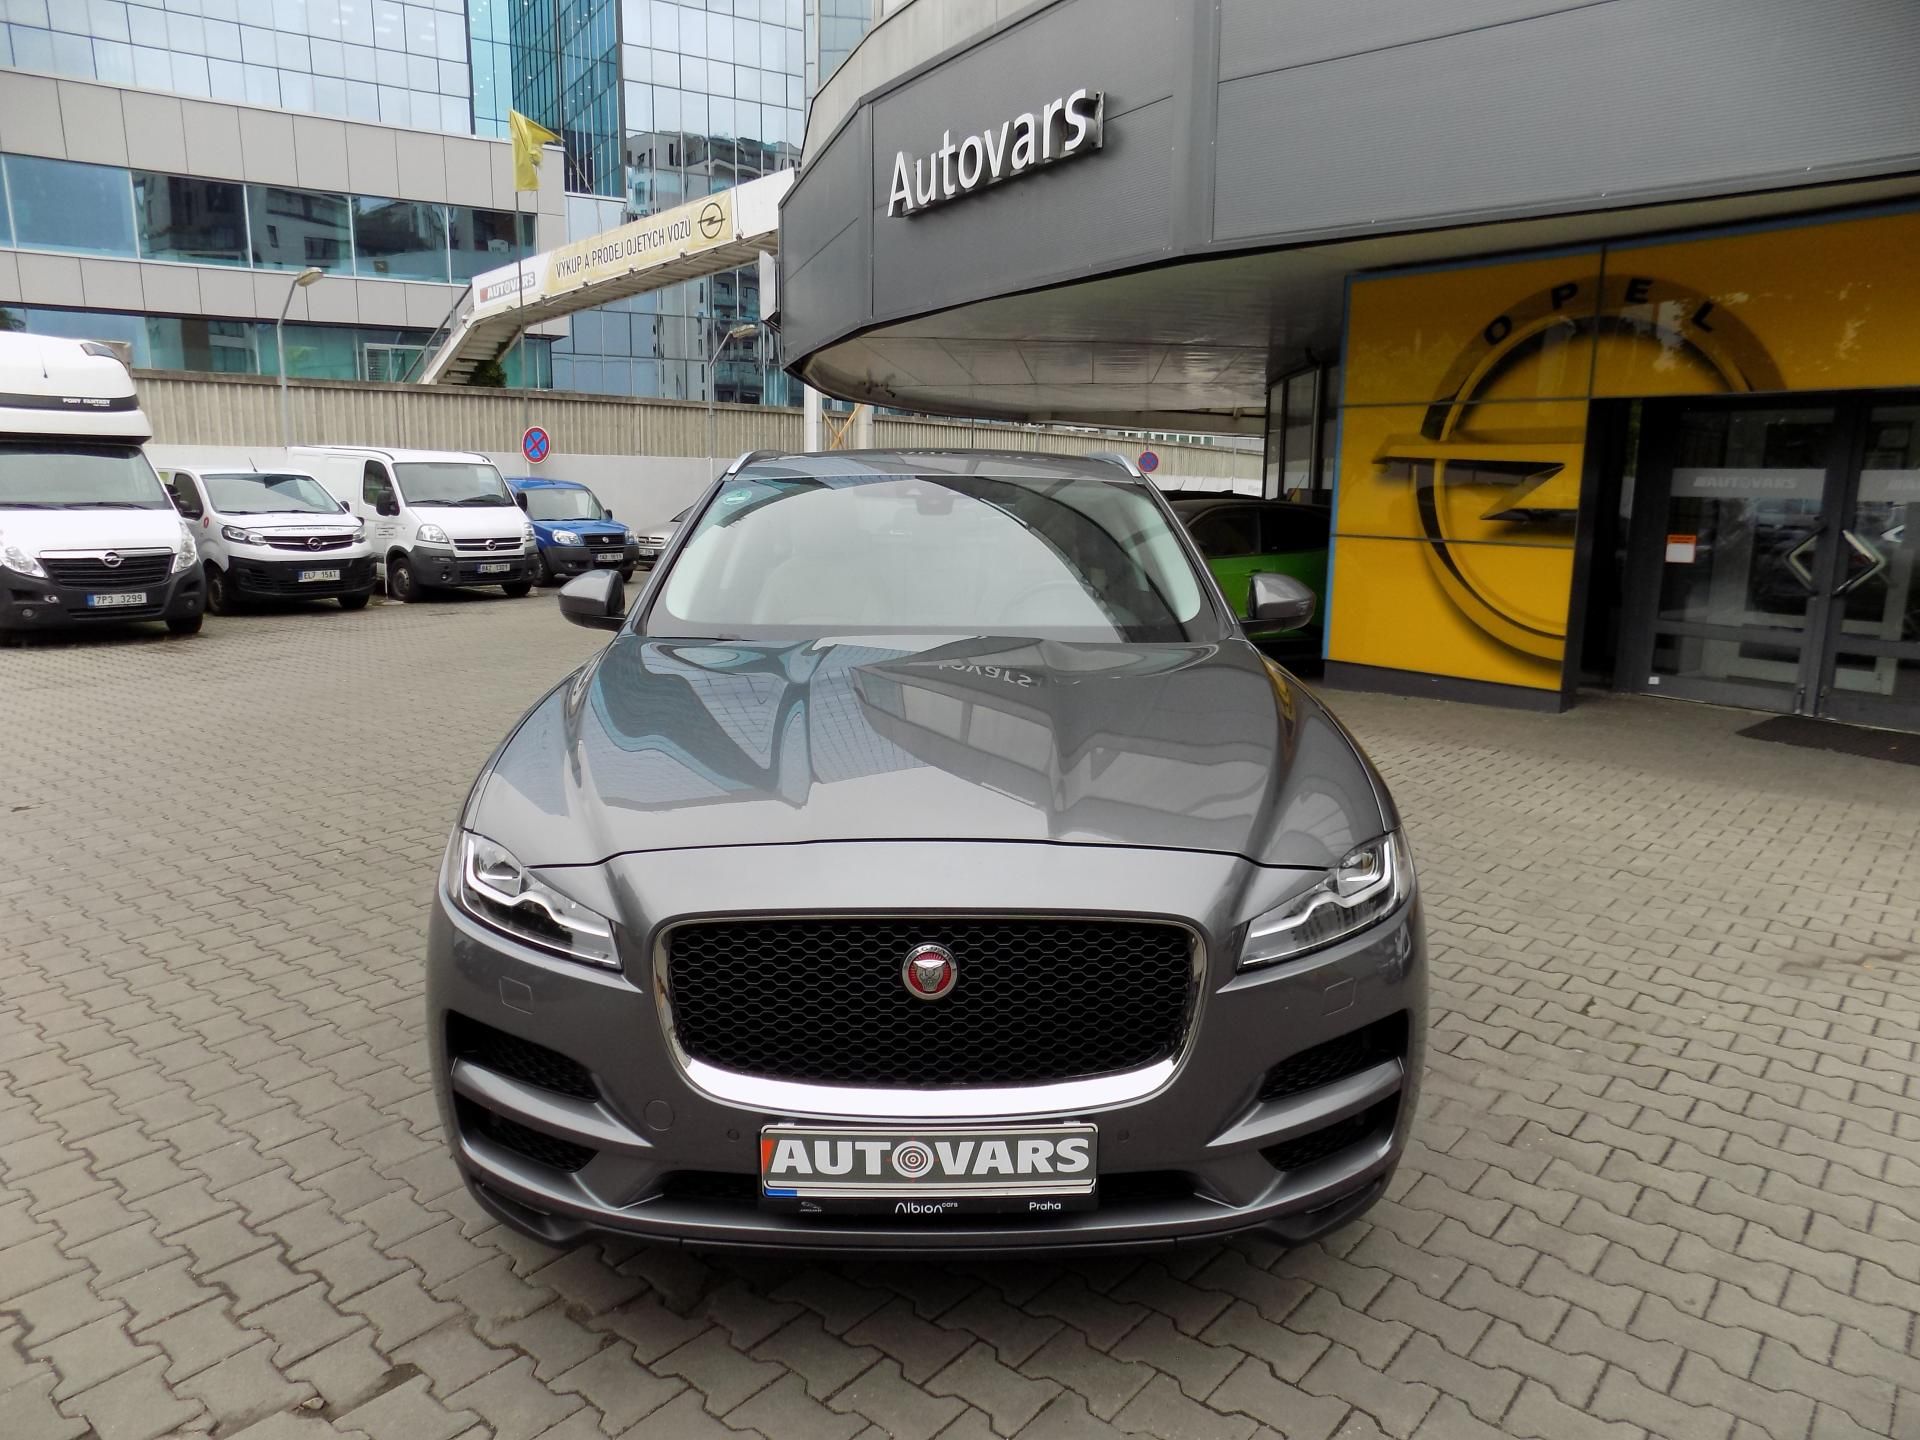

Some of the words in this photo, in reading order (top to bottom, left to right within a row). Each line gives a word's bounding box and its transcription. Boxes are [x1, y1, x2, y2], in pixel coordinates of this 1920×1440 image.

[887, 88, 1088, 217] Autovars
[556, 255, 581, 278] VÝKUP
[585, 254, 590, 270] A
[592, 242, 624, 267] PRODEJ
[626, 228, 665, 256] OJETÝCH
[667, 215, 691, 242] VOZŮ
[1484, 278, 1713, 345] OPEL
[96, 595, 113, 605] 7P3
[120, 594, 143, 603] 3299
[770, 1138, 1090, 1178] AUTOVARS
[895, 1202, 942, 1214] Albion
[1029, 1201, 1062, 1212] Praha
